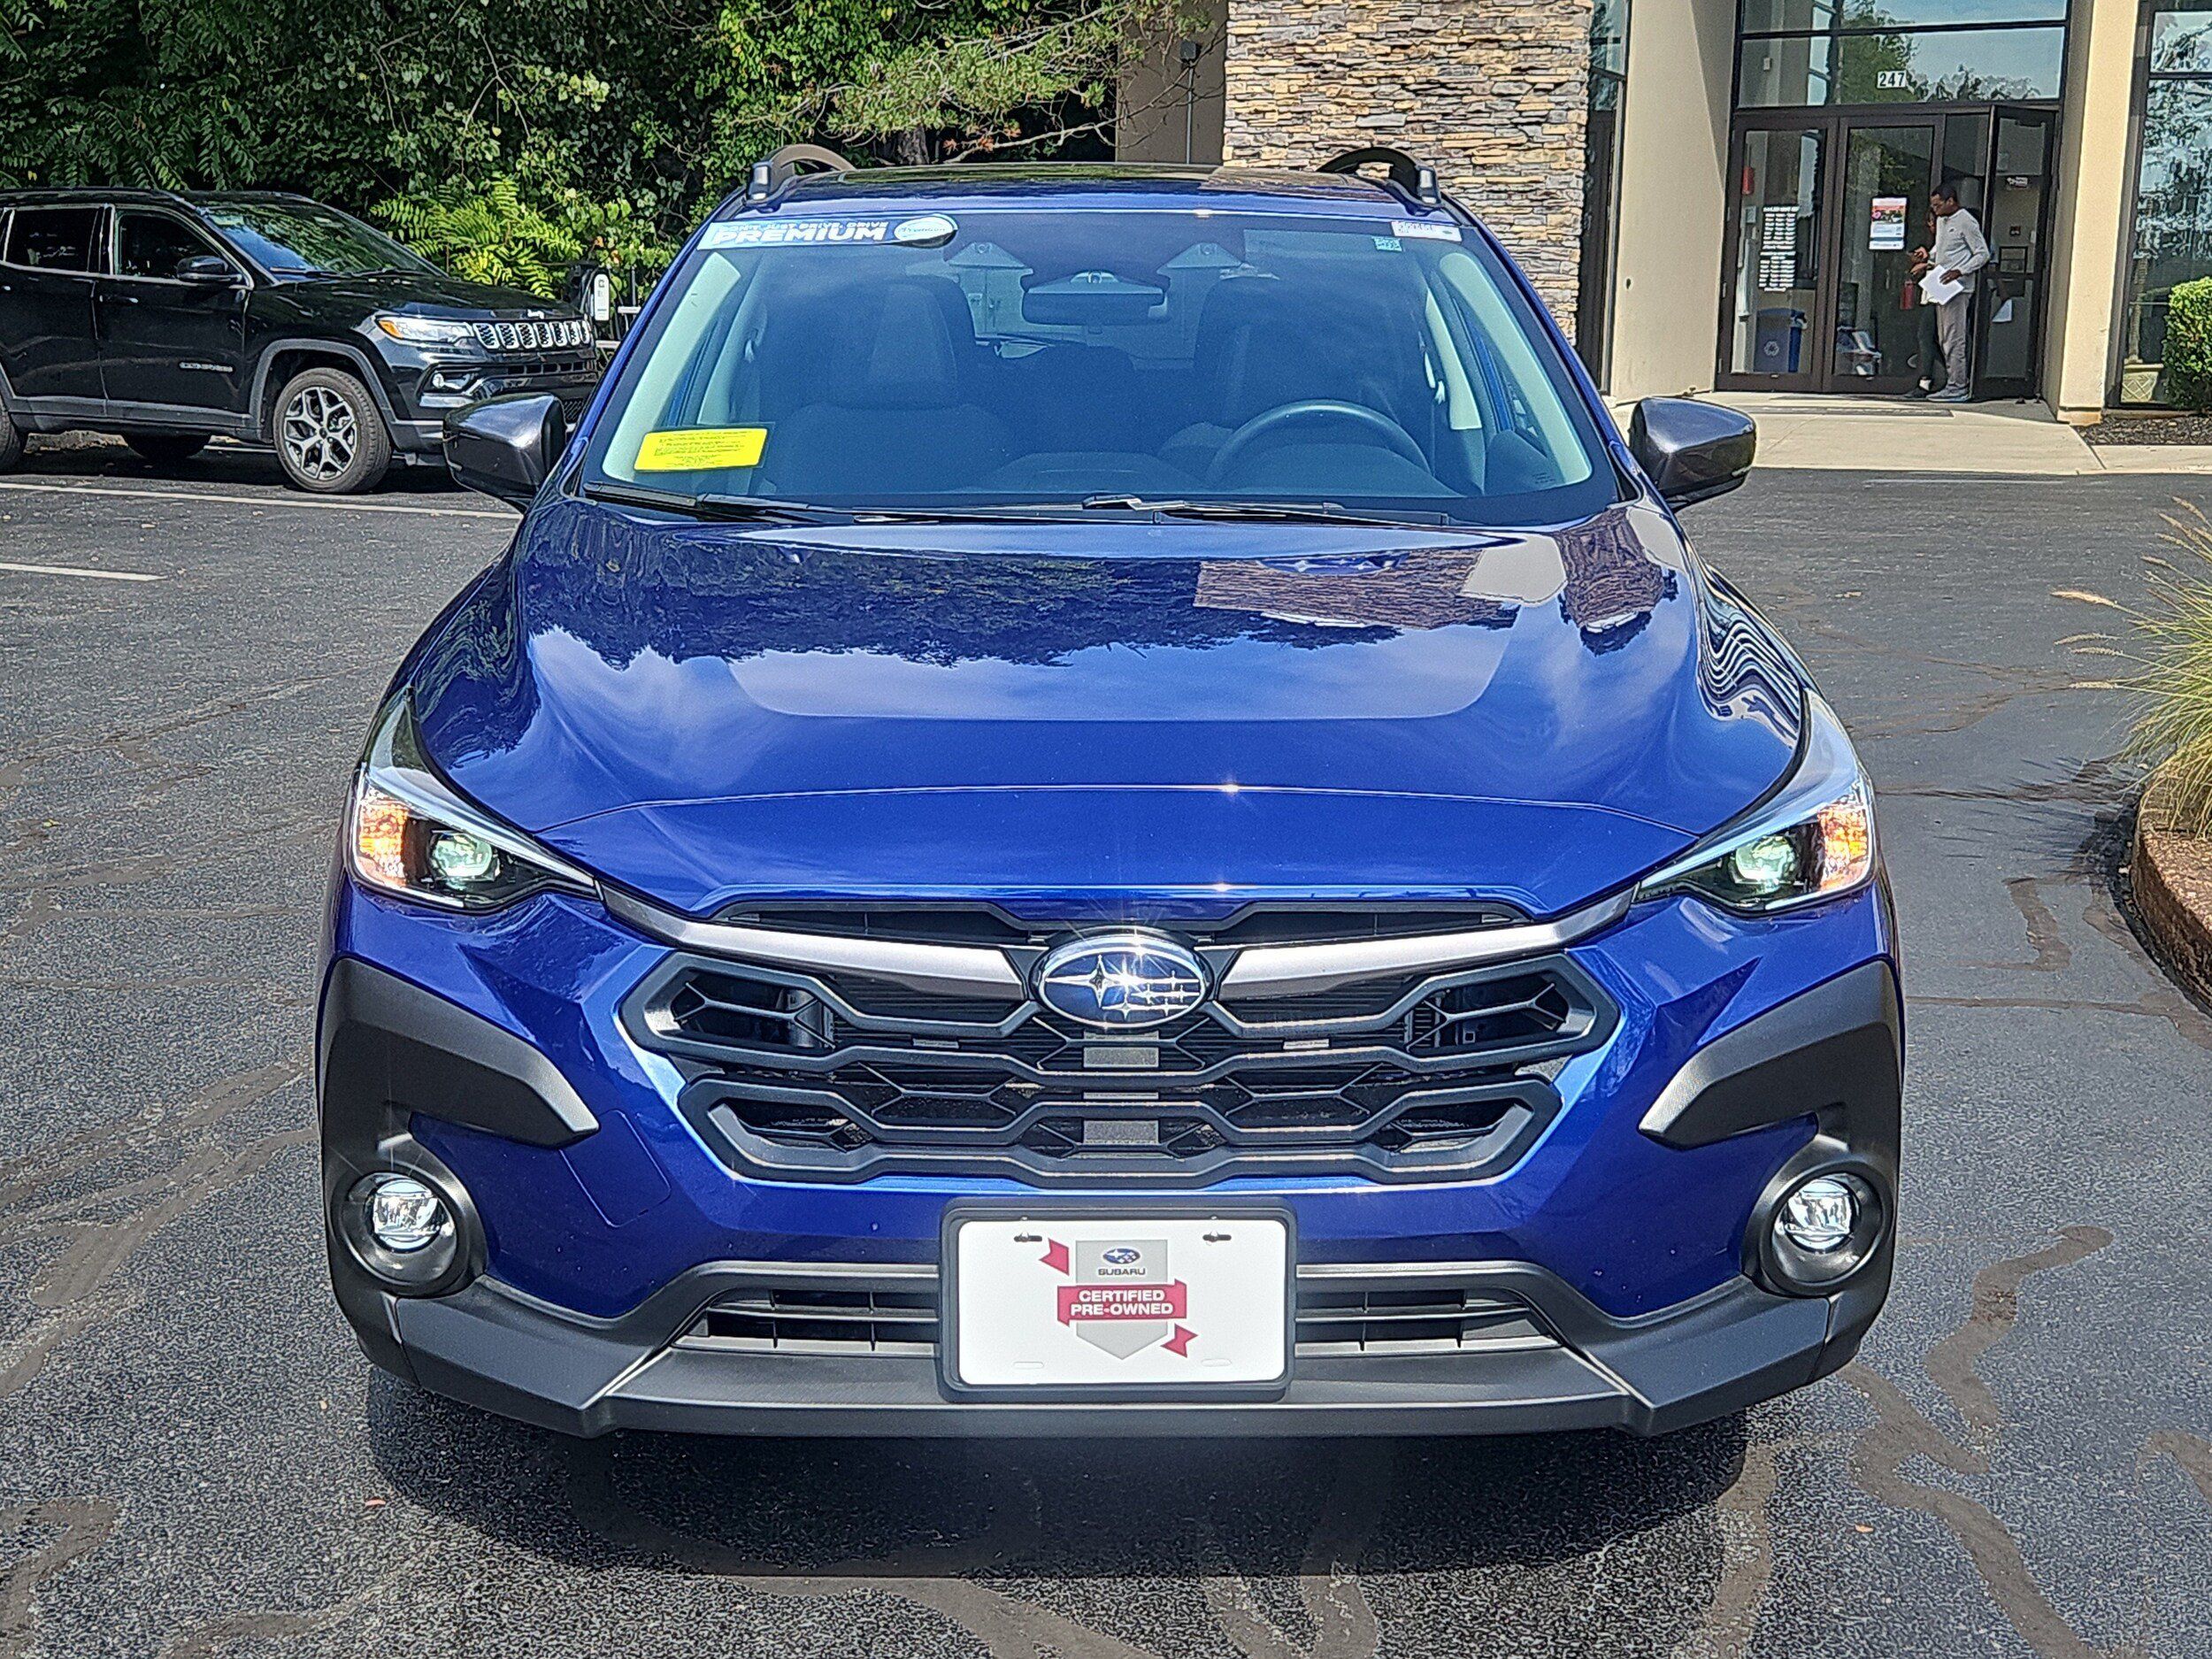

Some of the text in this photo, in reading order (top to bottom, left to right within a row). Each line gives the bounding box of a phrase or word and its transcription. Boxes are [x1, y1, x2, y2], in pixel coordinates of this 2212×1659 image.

[1879, 72, 1905, 87] 247
[711, 227, 887, 245] PREMIUM
[1079, 1289, 1165, 1302] CERTIFIED
[1070, 1302, 1174, 1317] PRE-OWNED
